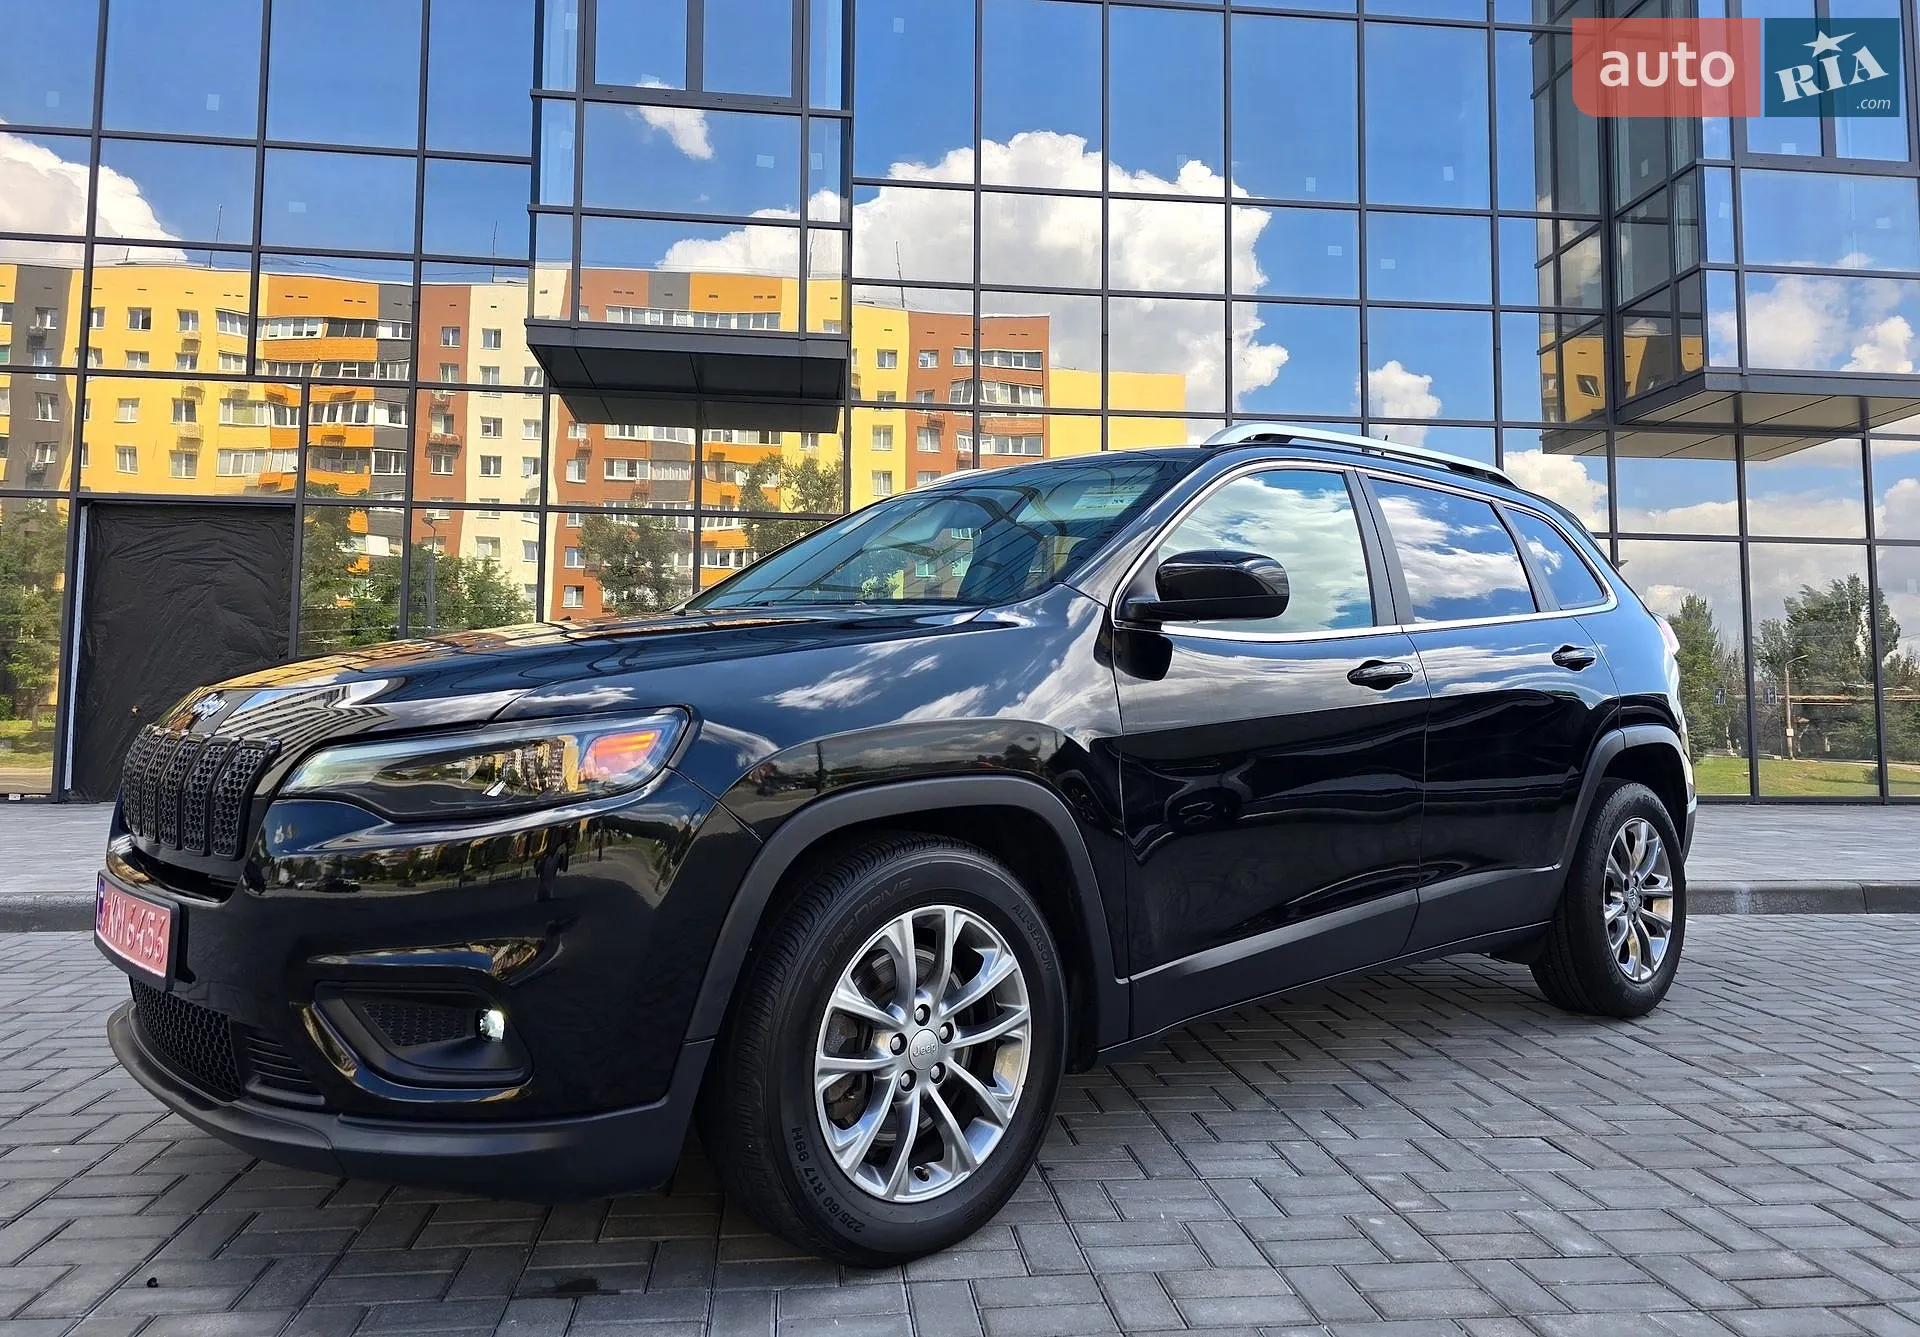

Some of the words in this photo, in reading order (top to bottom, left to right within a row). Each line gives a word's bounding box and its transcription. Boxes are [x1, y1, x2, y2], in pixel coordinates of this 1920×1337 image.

[913, 1043, 936, 1057] Jeep
[803, 1167, 826, 1197] R17
[822, 1196, 866, 1233] 225/60
